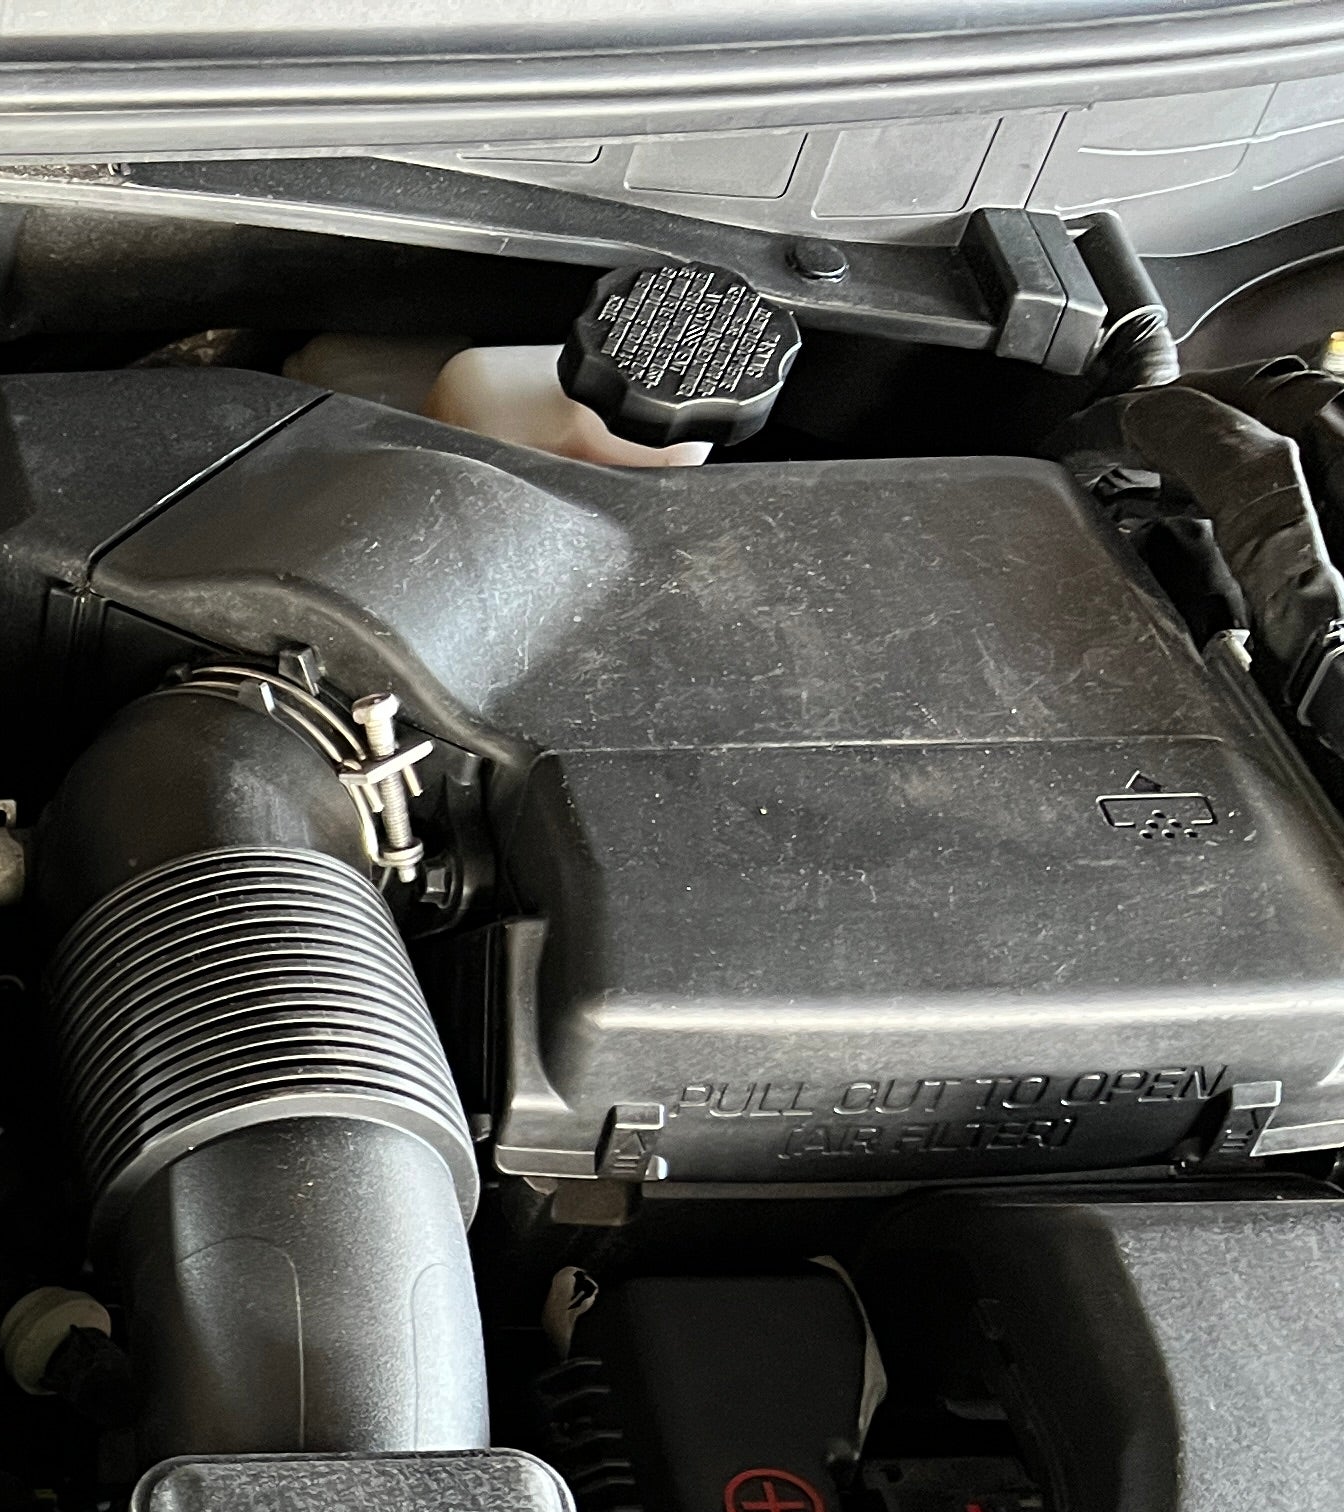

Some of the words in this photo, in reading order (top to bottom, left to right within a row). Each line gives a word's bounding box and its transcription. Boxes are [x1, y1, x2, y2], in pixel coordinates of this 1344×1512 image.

[668, 1079, 813, 1119] PULL
[832, 1077, 962, 1115] OUT
[975, 1072, 1050, 1111] TO
[1059, 1062, 1228, 1107] OPEN
